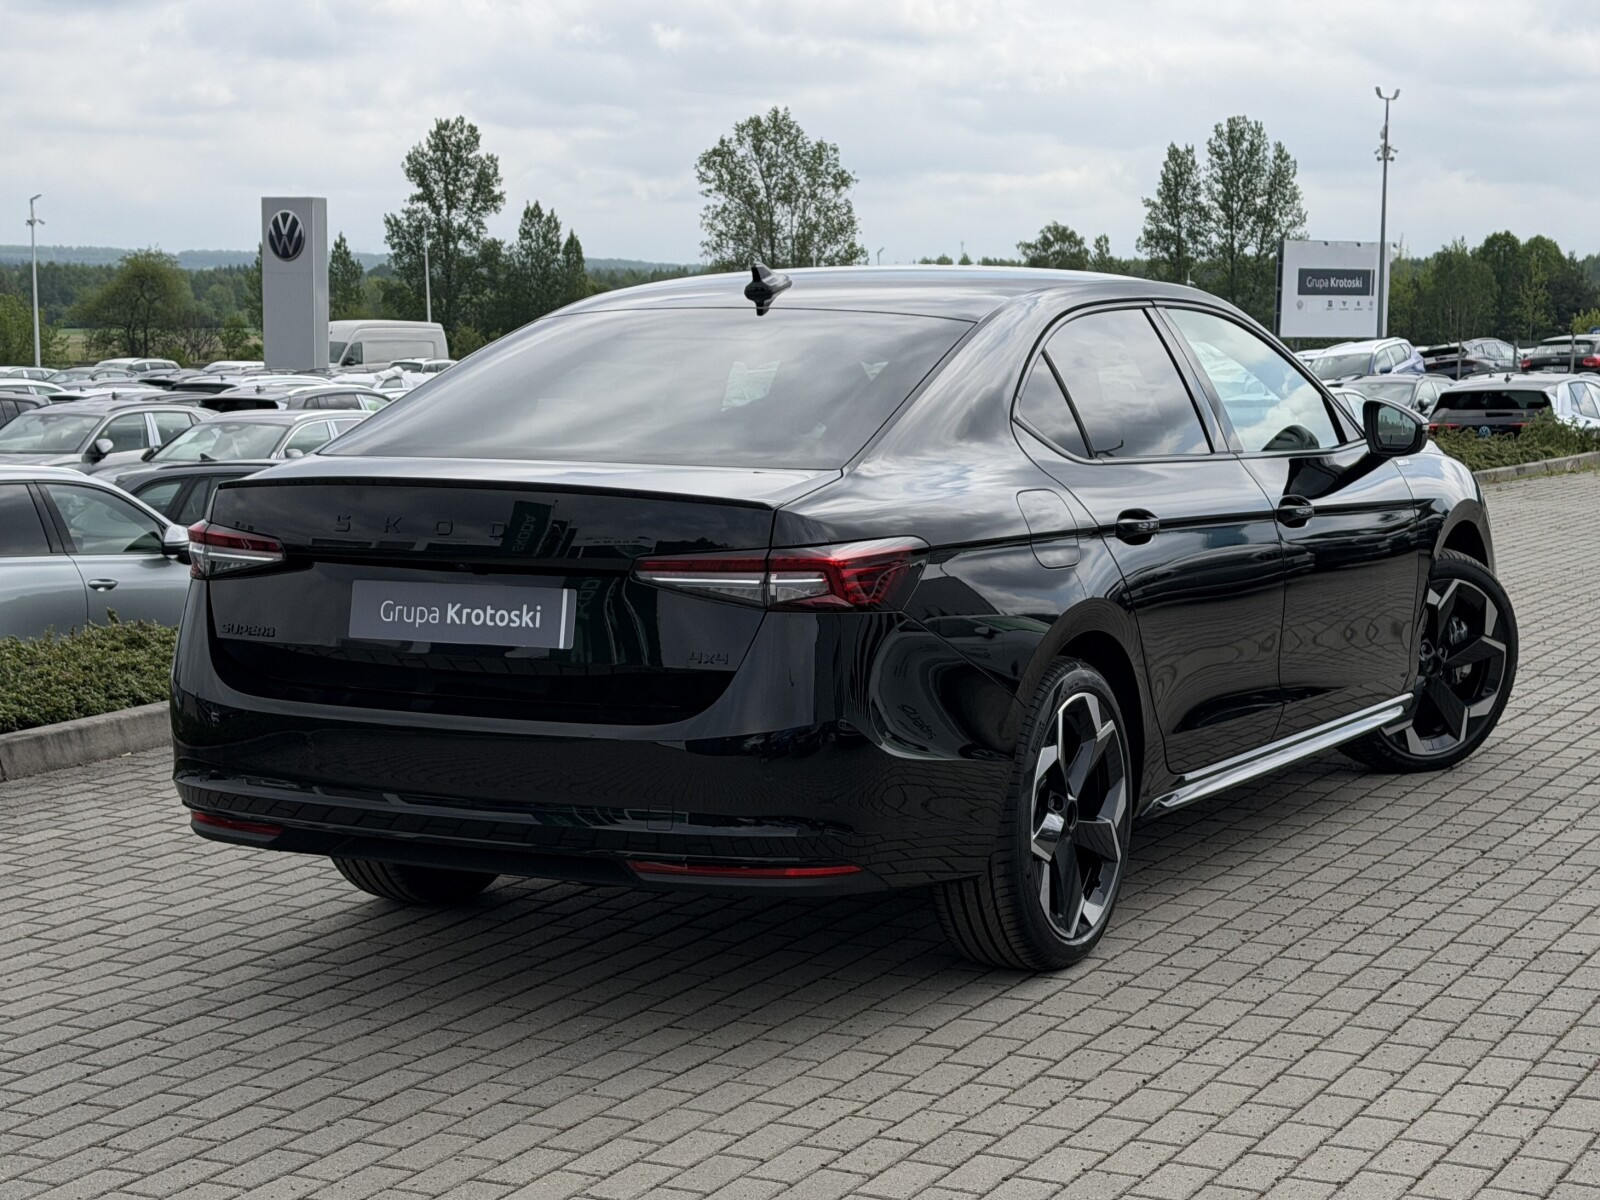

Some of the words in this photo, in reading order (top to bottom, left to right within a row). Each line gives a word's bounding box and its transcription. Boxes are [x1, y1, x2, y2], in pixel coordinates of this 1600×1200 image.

[1306, 276, 1329, 289] Grupa
[1330, 276, 1363, 288] Krotoski
[380, 600, 440, 628] Grupa
[446, 602, 542, 629] Krotoski
[221, 623, 276, 638] SUPERB
